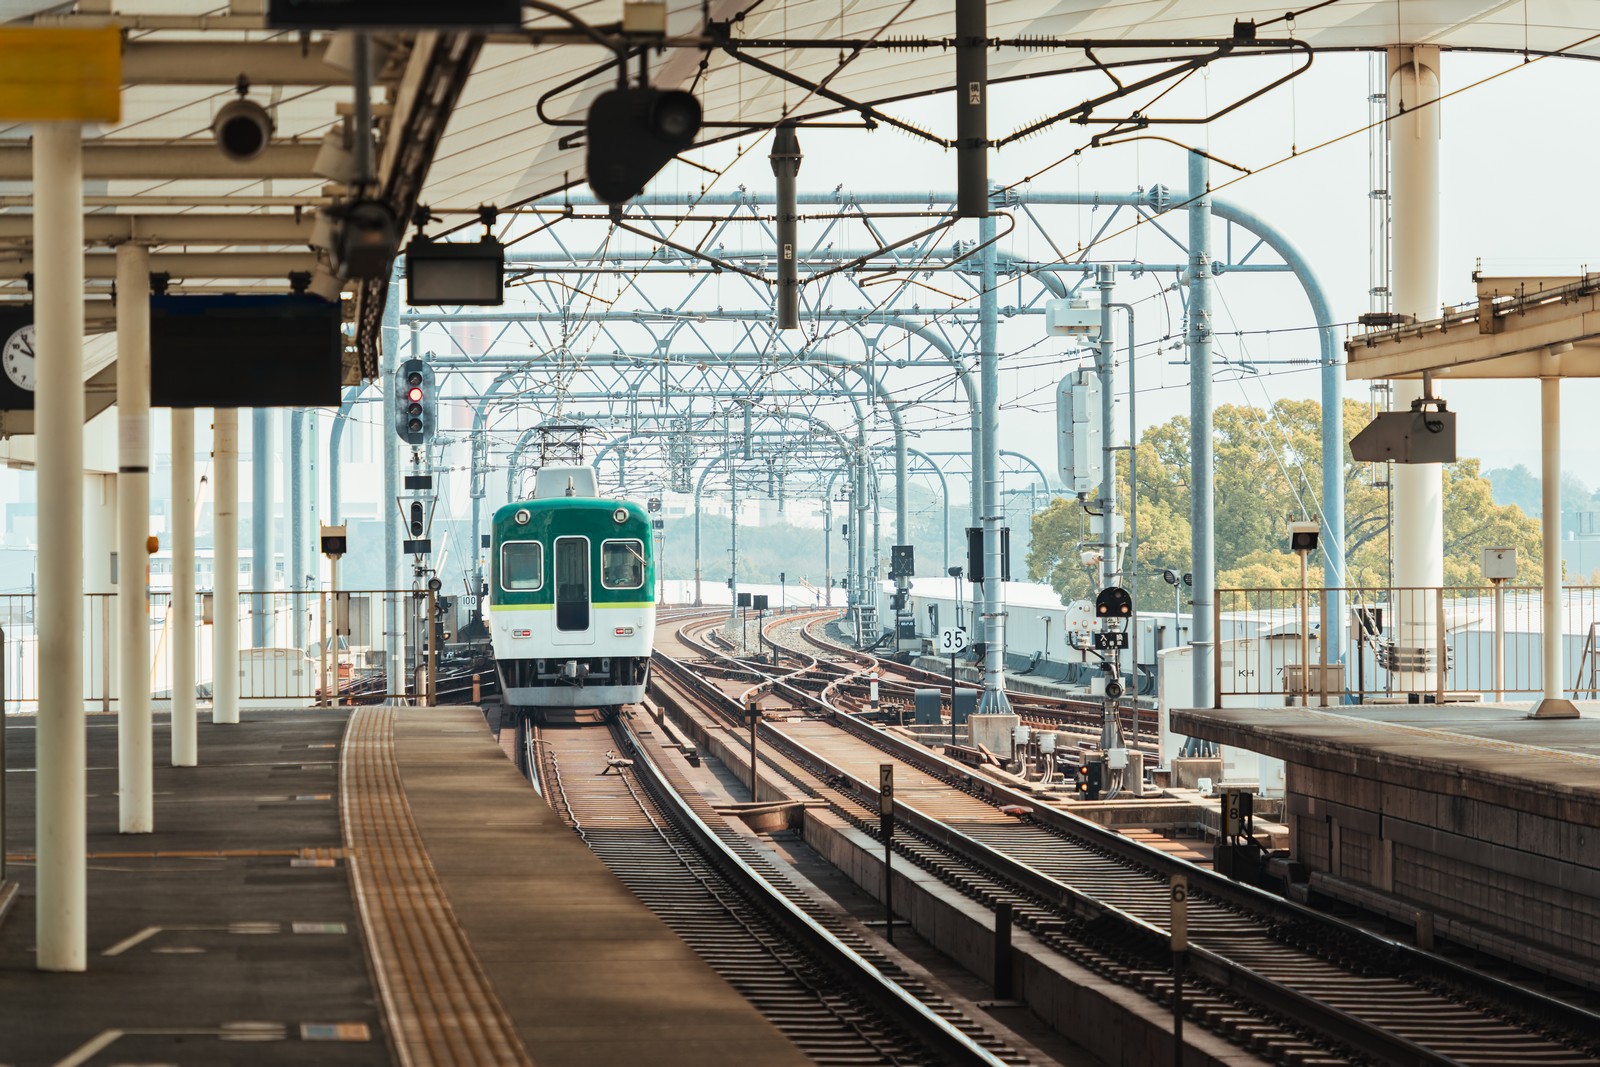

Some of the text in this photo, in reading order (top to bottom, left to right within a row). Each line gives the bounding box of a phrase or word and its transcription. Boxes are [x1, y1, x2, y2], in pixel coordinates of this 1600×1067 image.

[463, 597, 476, 605] 100
[943, 631, 963, 648] 35
[1238, 669, 1254, 677] KH
[1173, 884, 1185, 902] 6
